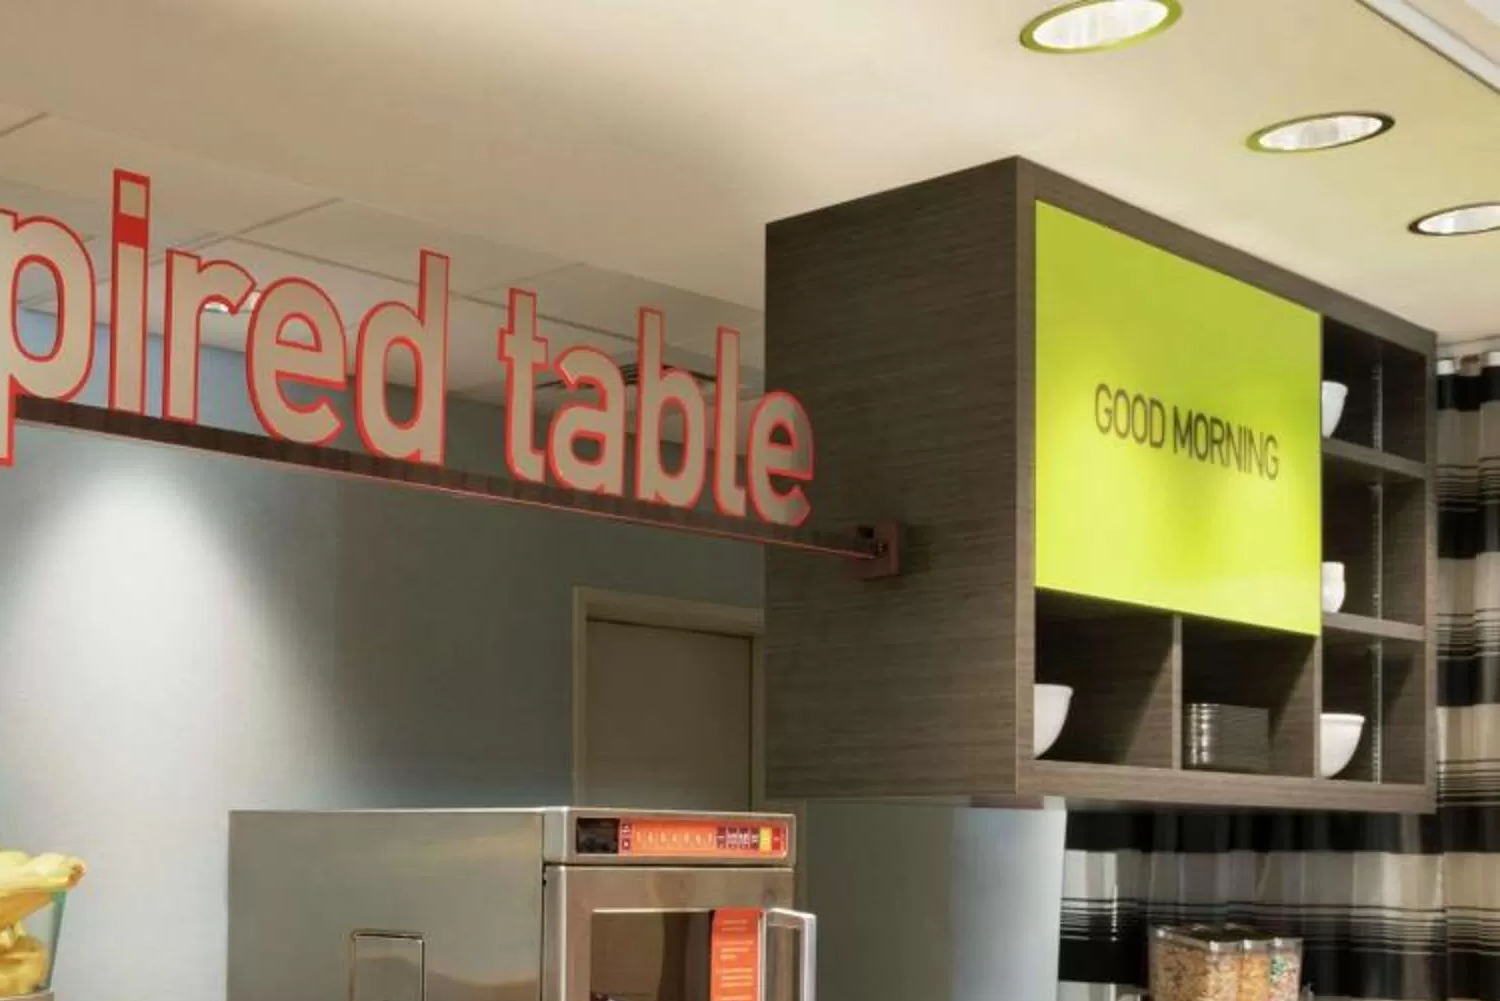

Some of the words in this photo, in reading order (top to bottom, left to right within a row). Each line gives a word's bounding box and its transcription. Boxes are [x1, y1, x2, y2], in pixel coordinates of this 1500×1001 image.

[497, 287, 816, 527] table
[1094, 383, 1166, 449] GOOD
[1173, 404, 1280, 481] MORNING
